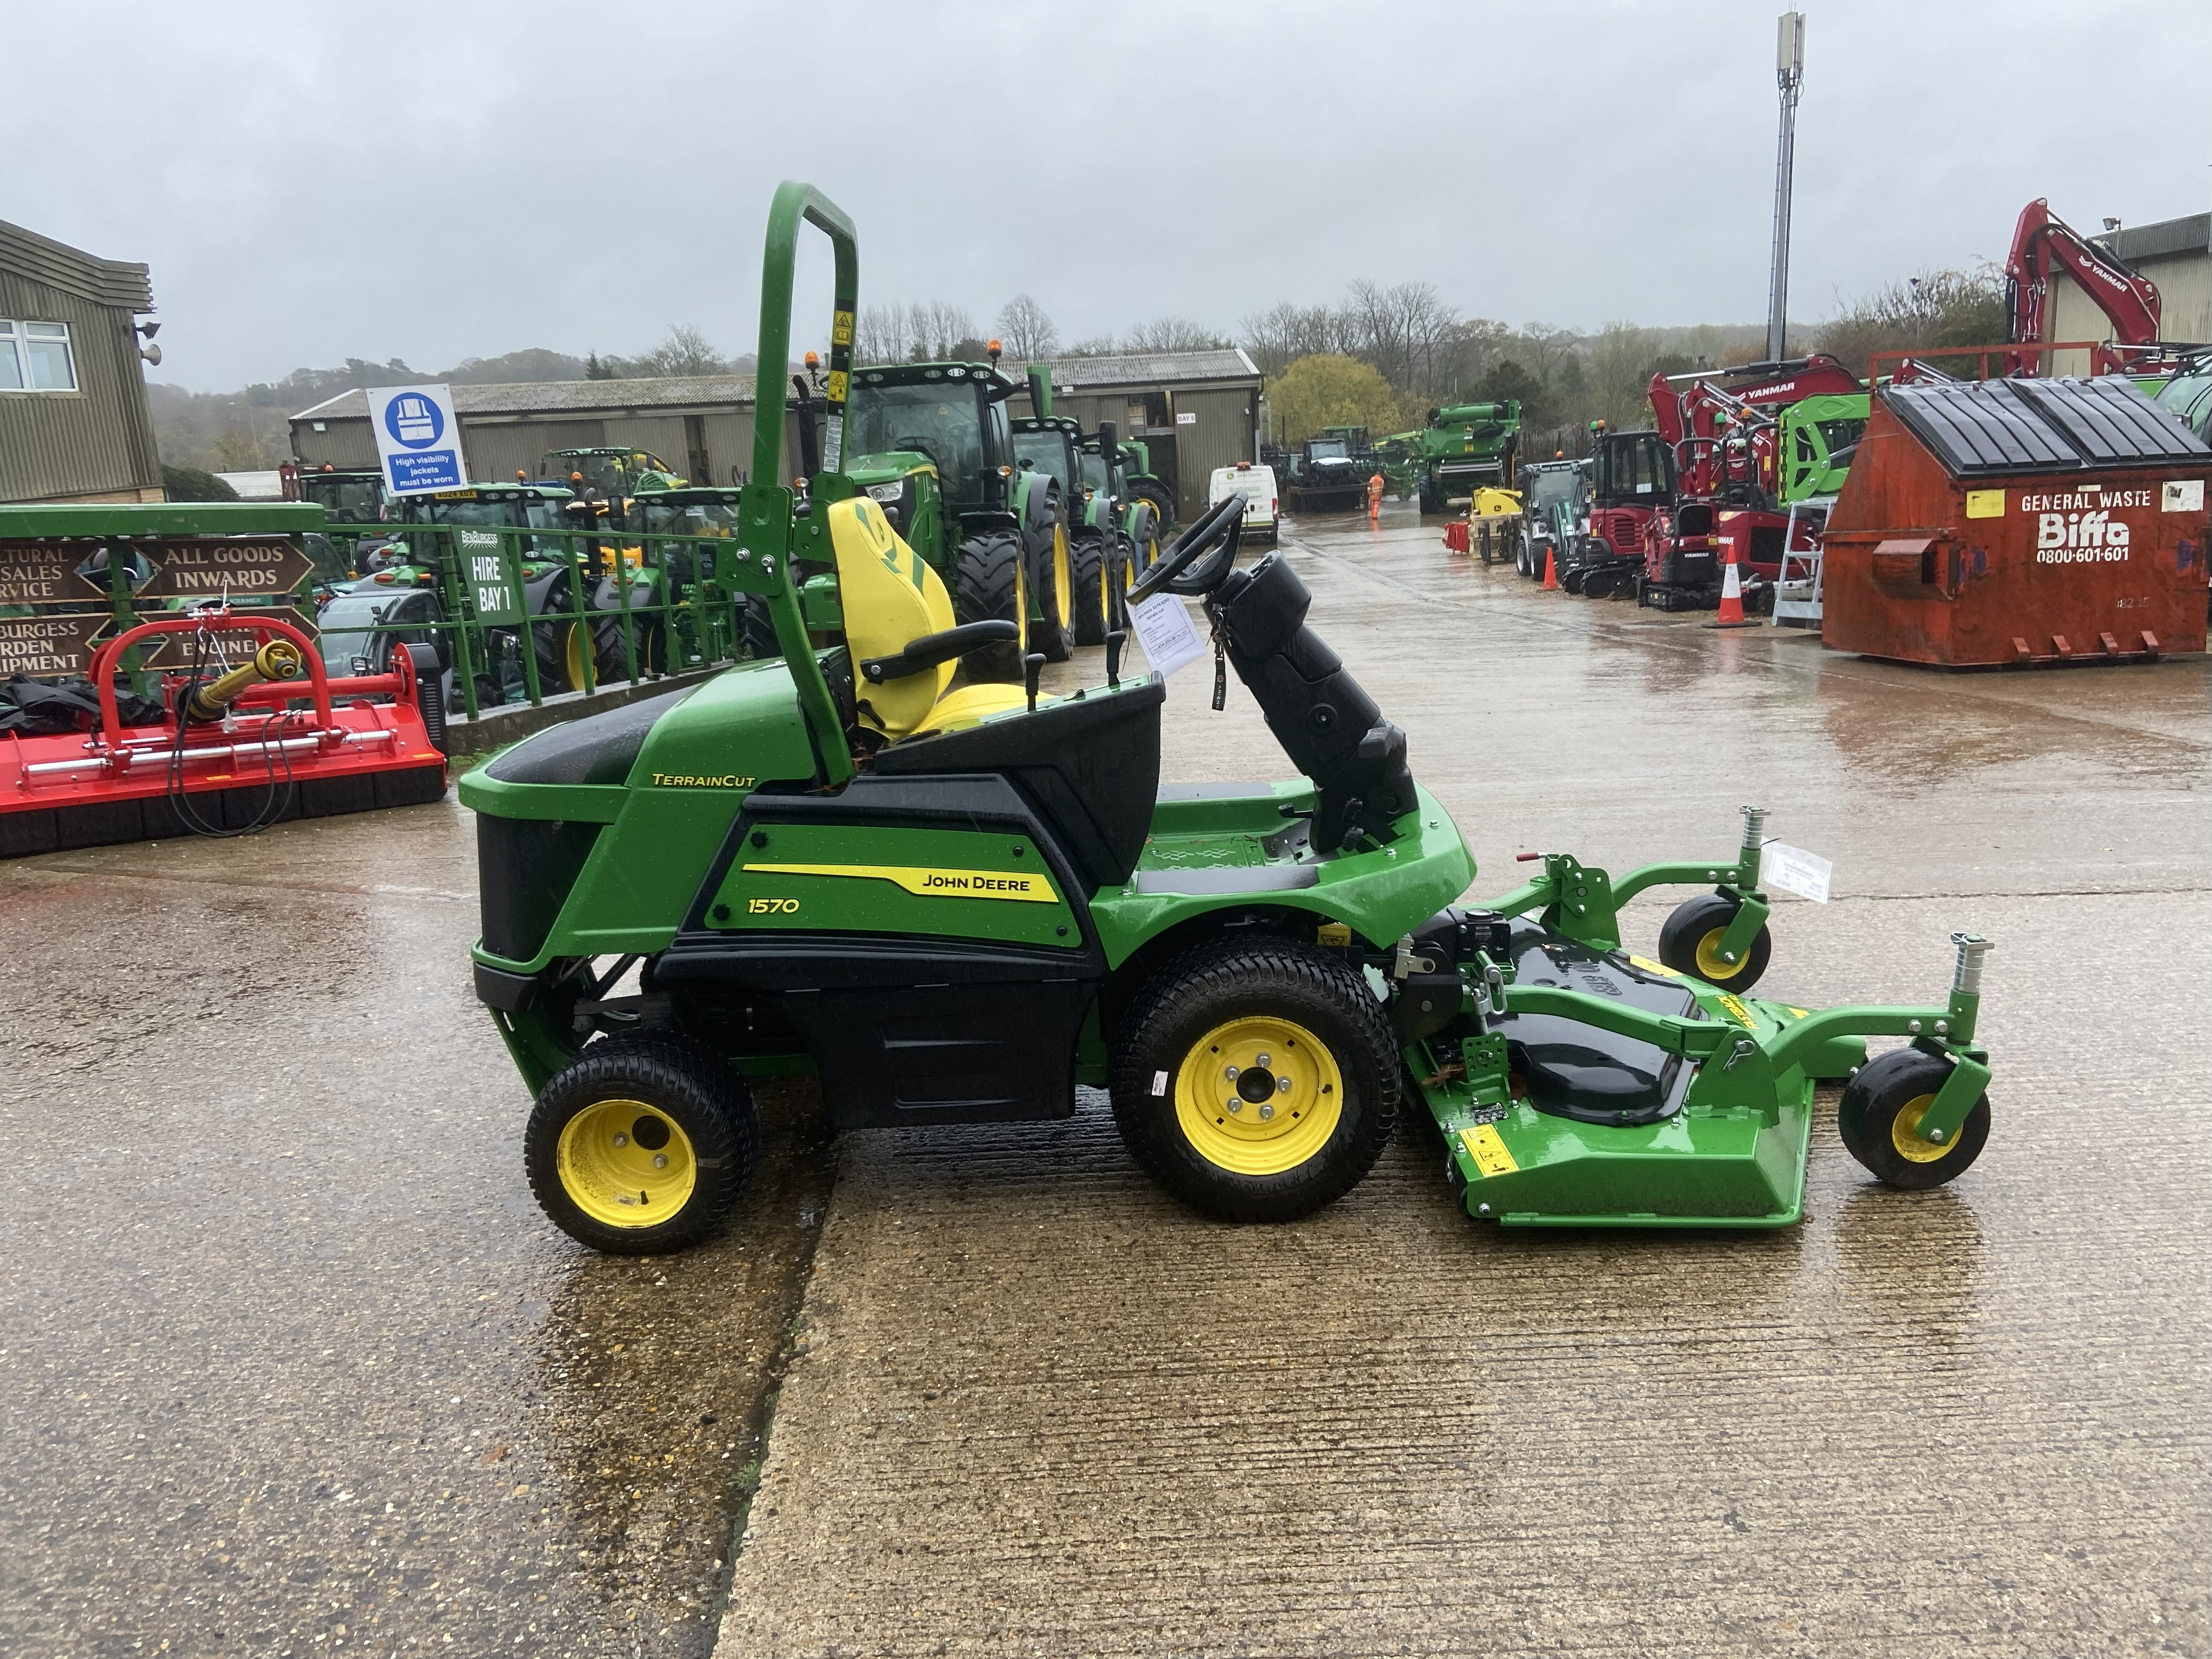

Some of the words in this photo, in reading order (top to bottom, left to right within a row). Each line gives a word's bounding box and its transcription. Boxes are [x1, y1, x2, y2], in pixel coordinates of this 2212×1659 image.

[2092, 264, 2128, 292] YANMAR
[1748, 382, 1795, 399] YANMAR
[395, 456, 415, 467] High
[416, 455, 449, 464] visibility
[410, 467, 439, 477] jackets
[400, 479, 420, 487] must
[2022, 493, 2092, 512] GENERAL
[2099, 490, 2151, 507] WASTE
[2038, 510, 2130, 549] Biffa
[164, 549, 208, 565] ALL
[213, 546, 284, 563] GOODS
[1, 565, 63, 582] SALES
[472, 556, 501, 582] HIRE
[175, 569, 277, 589] INWARDS
[478, 586, 501, 612] BAY
[504, 586, 510, 610] 1
[0, 654, 79, 673] IPMENT
[923, 874, 968, 889] JOHN
[973, 876, 1030, 891] DEERE
[749, 899, 800, 913] 1570
